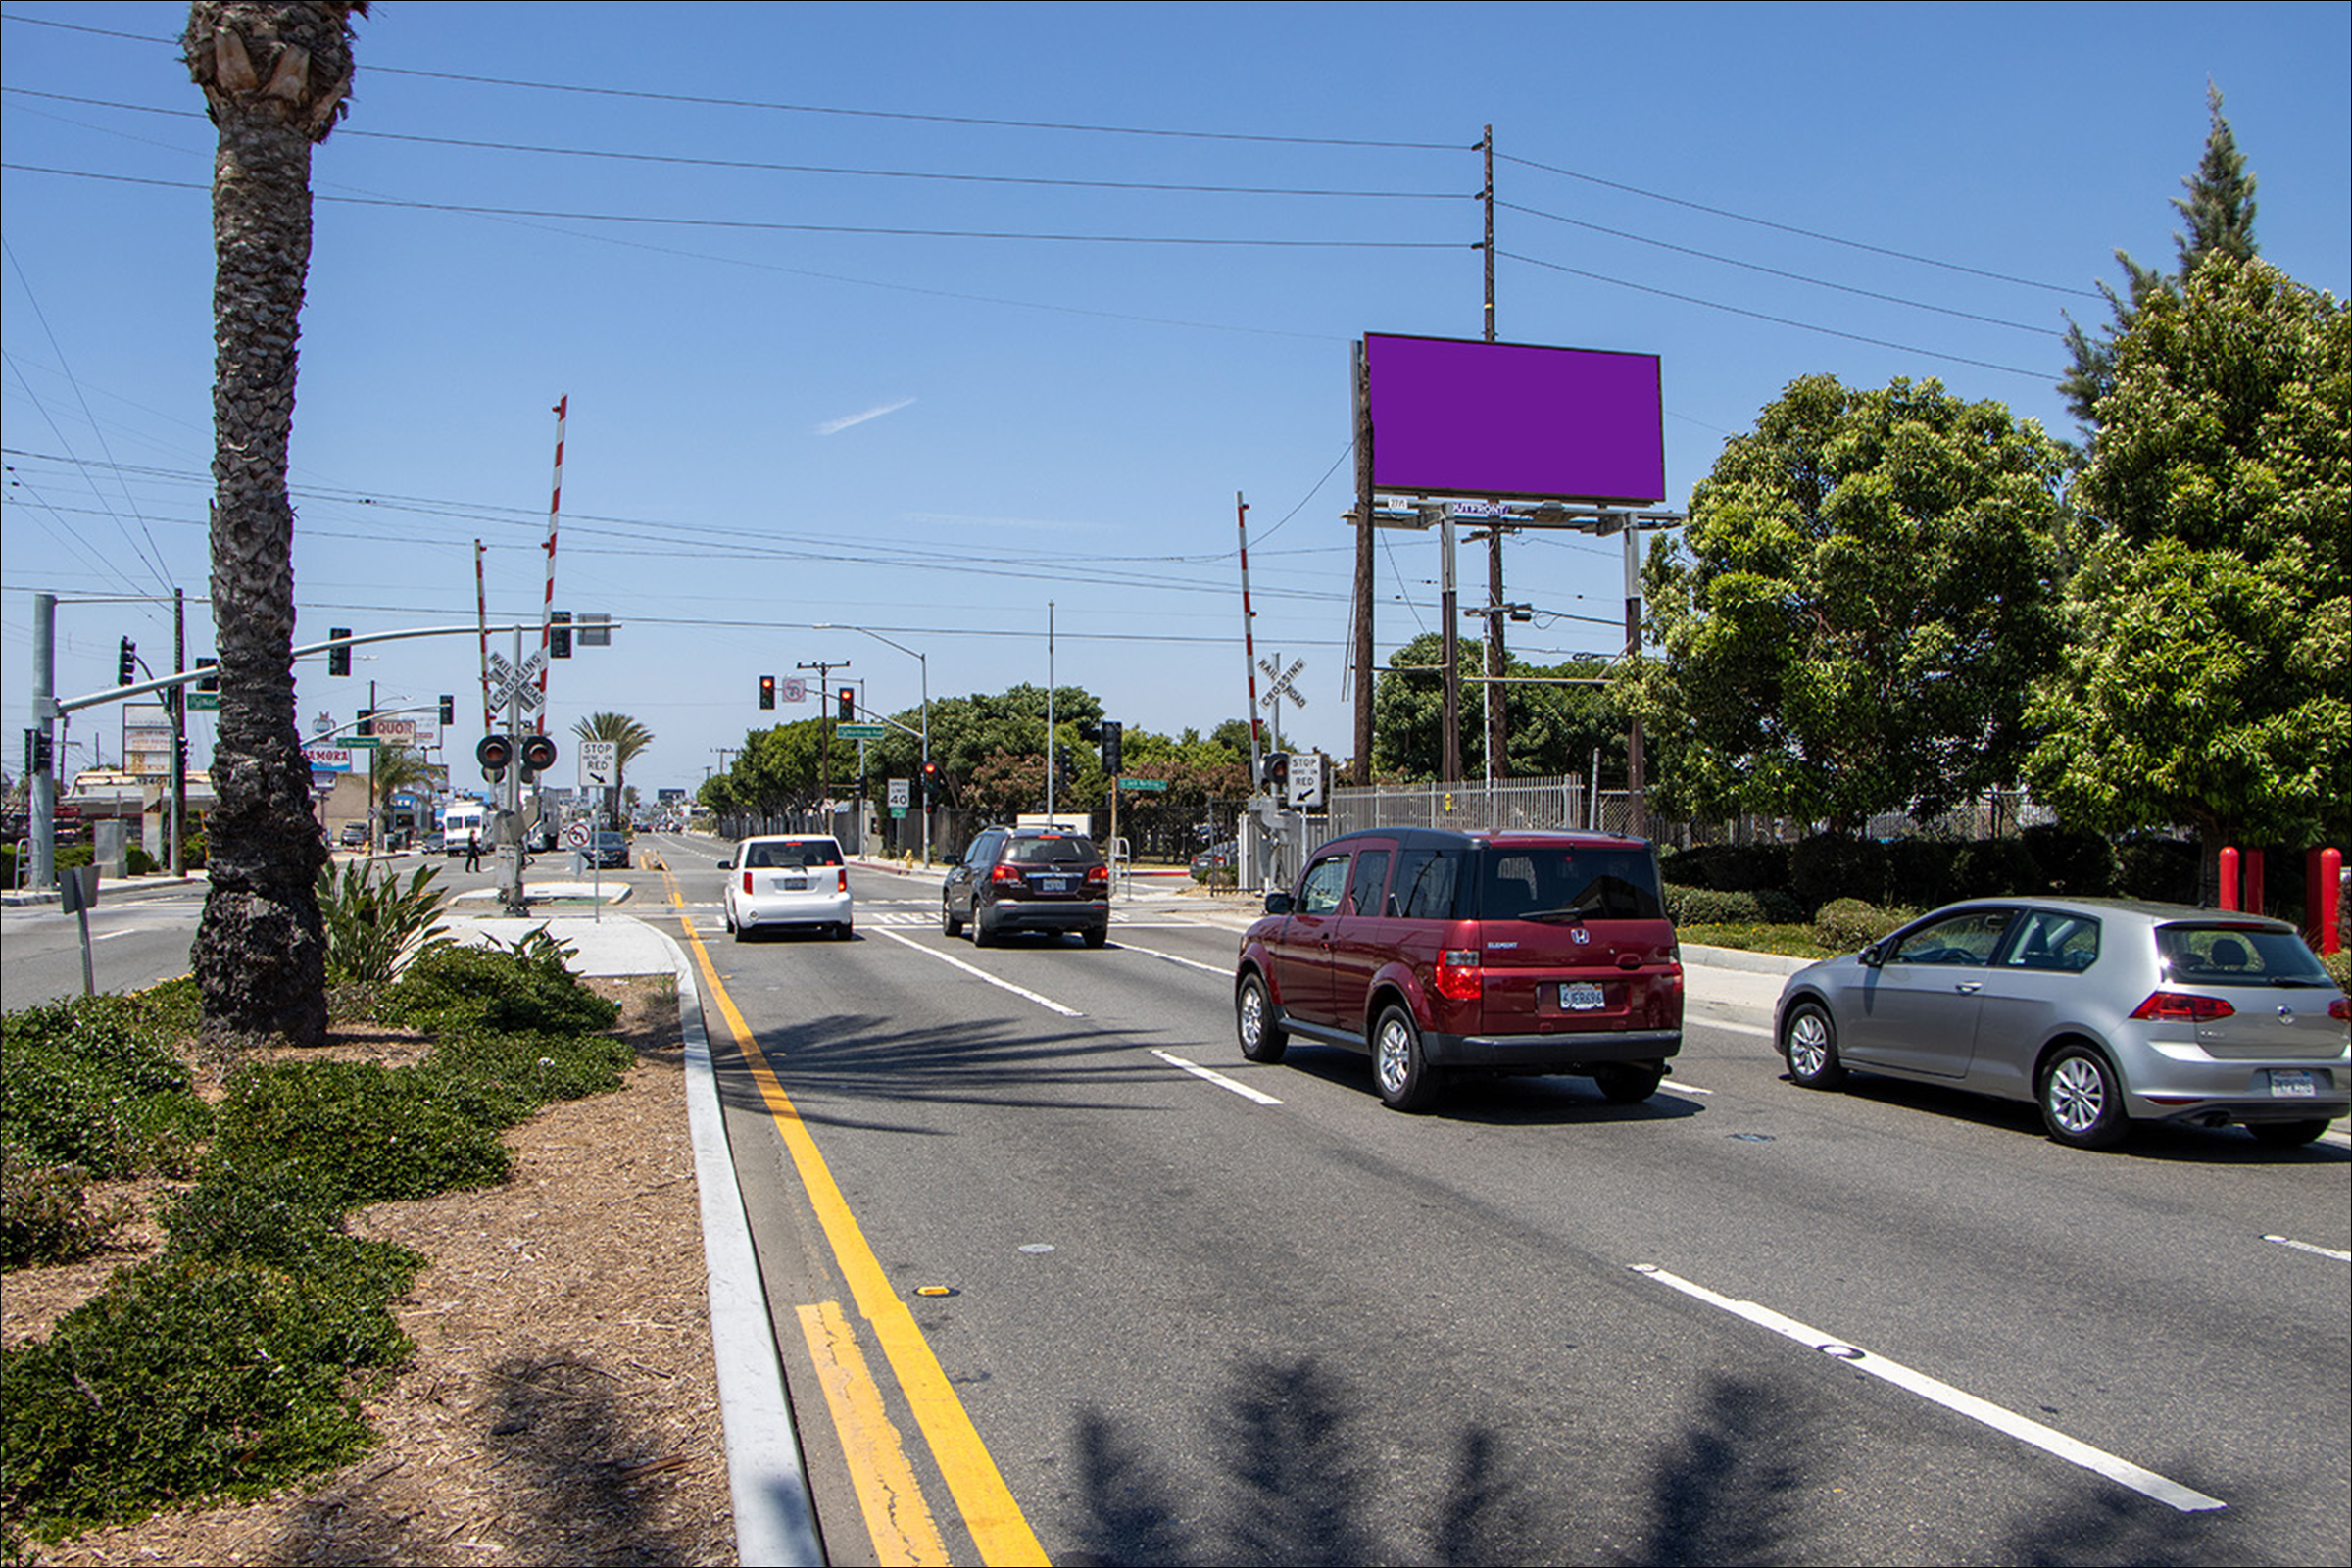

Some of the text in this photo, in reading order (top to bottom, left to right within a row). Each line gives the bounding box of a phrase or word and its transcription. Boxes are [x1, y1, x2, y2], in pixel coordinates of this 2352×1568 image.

[489, 653, 544, 705] RAIL ROAD
[493, 655, 541, 703] CROSSING
[1258, 659, 1306, 708] RAIL ROAD
[1261, 660, 1303, 707] CROSSING
[584, 744, 612, 753] STOP
[587, 760, 608, 770] RED
[1293, 758, 1316, 767] STOP
[1296, 777, 1314, 786] RED
[890, 795, 907, 805] 40
